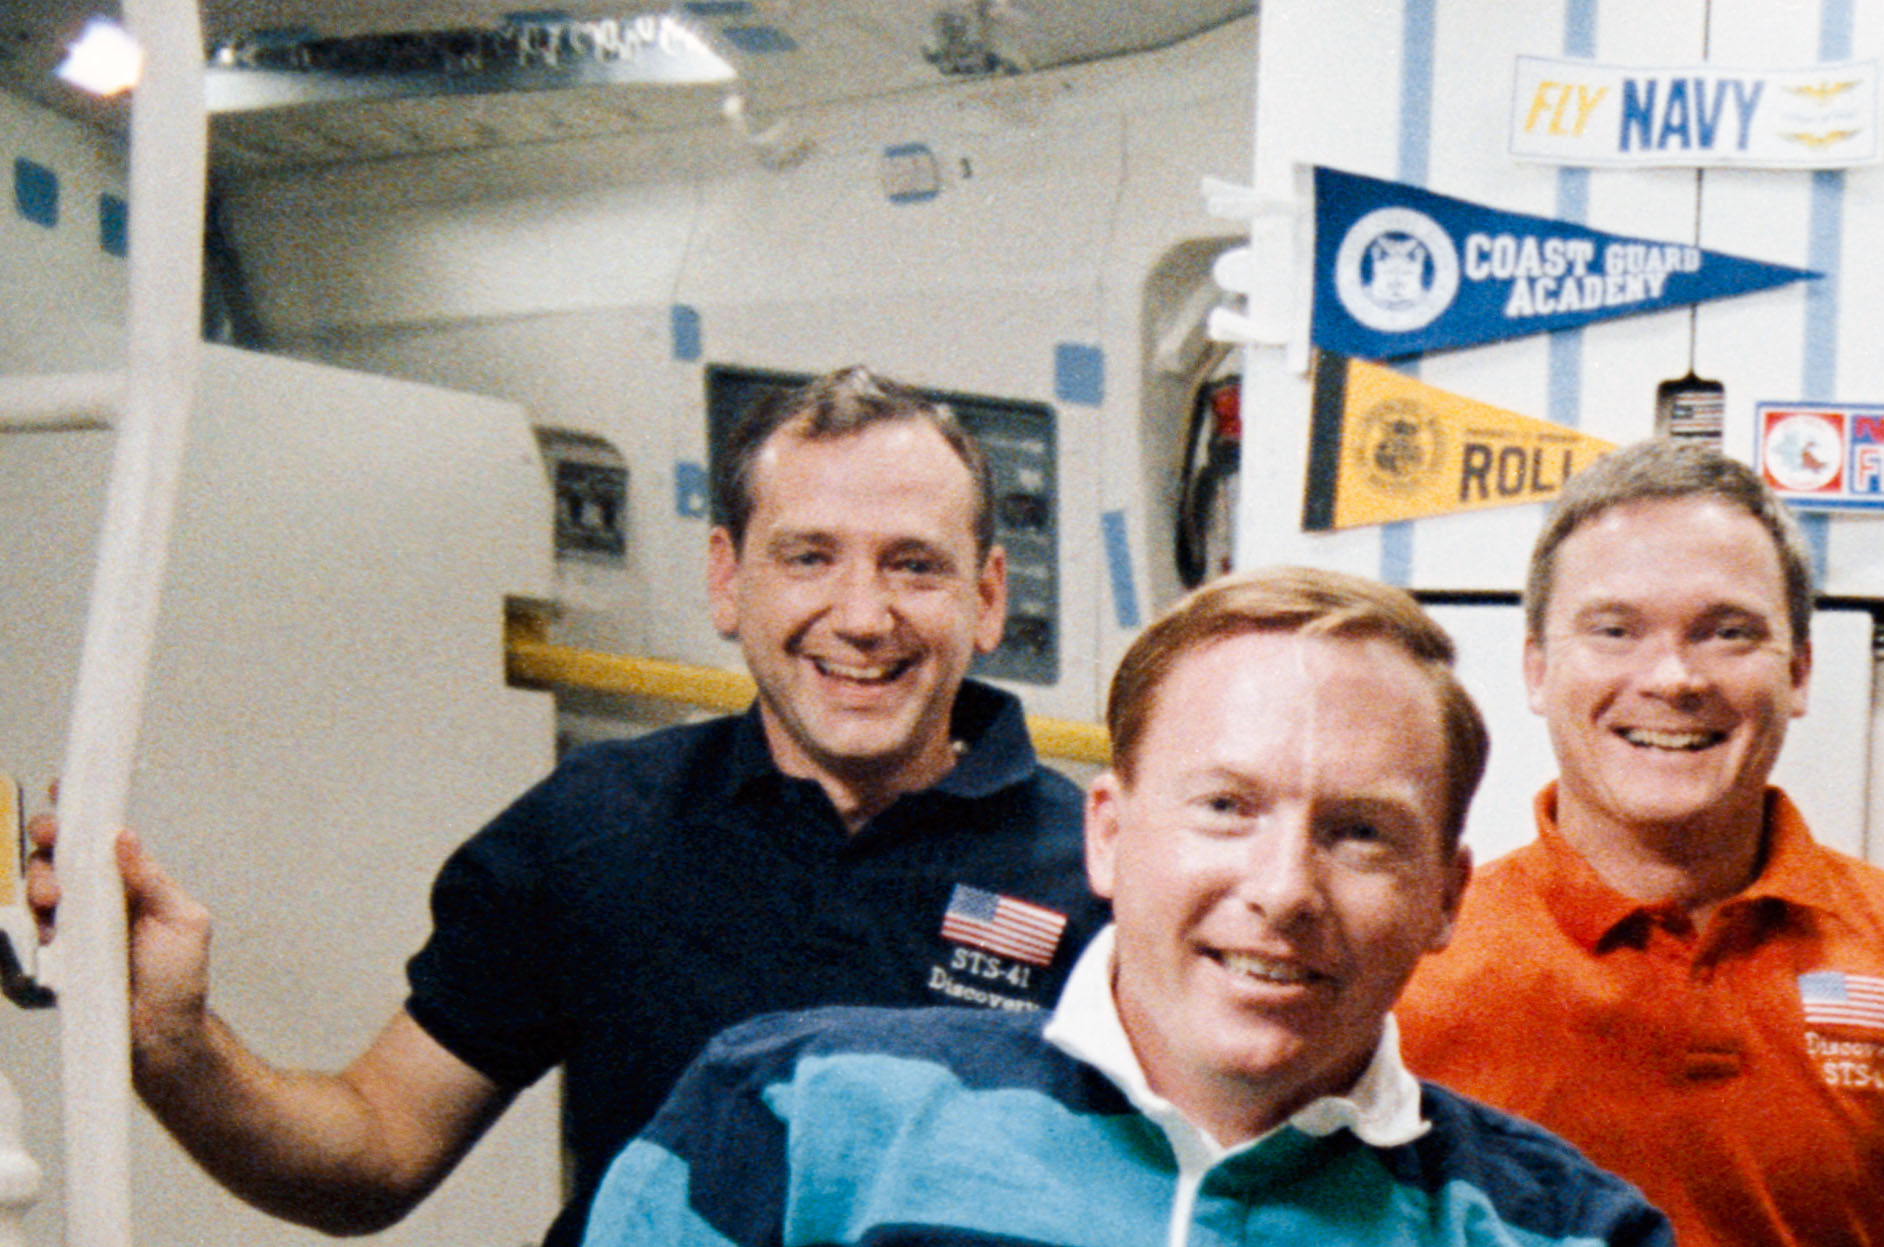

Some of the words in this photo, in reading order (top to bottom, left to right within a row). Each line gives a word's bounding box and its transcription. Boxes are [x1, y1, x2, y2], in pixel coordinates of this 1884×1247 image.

[1523, 80, 1609, 137] FLY
[1618, 77, 1766, 152] NAVY
[1464, 232, 1595, 282] COAST
[1604, 241, 1701, 276] GUARD
[1504, 272, 1669, 318] ACADEMY
[950, 948, 1031, 989] STS-41
